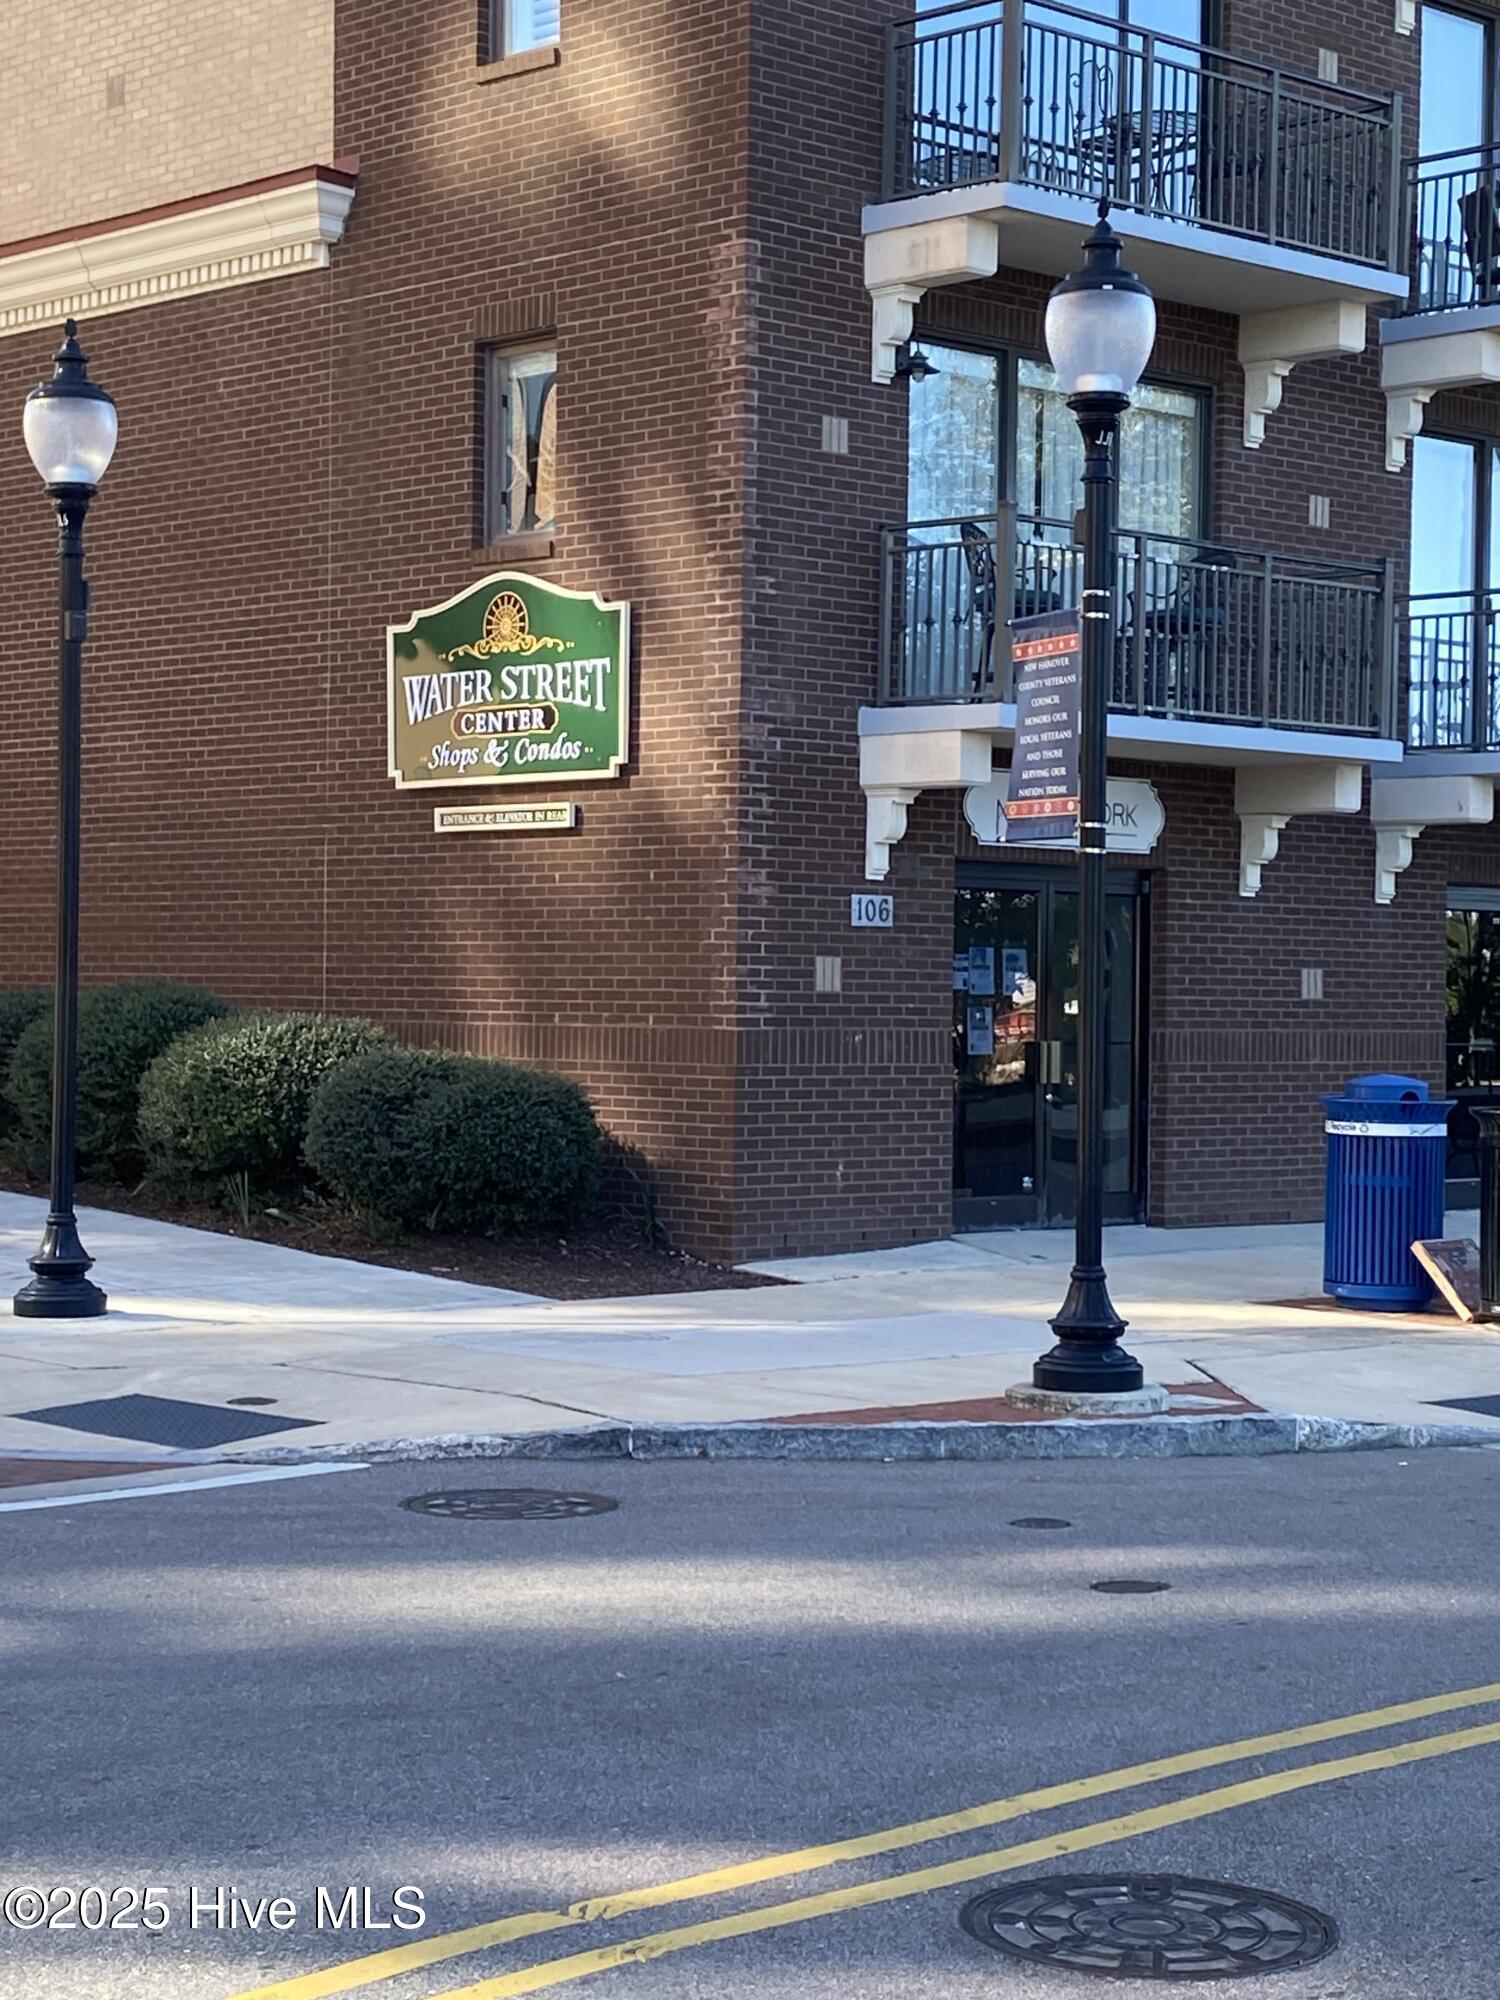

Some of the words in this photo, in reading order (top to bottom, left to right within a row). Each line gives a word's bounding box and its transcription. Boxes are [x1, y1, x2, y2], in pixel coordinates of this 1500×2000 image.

[1024, 662, 1037, 672] NEW
[1038, 656, 1070, 671] HANOVER
[1018, 679, 1043, 692] COUNTY
[1044, 673, 1077, 687] VETERANS
[402, 669, 494, 726] WATER
[501, 657, 611, 712] STREET
[1031, 695, 1060, 707] COUNCIL
[461, 708, 546, 735] CENTER
[1024, 714, 1051, 726] HONORS
[1052, 711, 1068, 723] OUR
[1020, 734, 1039, 745] LOCAL
[1040, 729, 1072, 742] VETERANS
[428, 741, 480, 774] Shops
[483, 739, 509, 767] &
[515, 732, 583, 765] Condos
[1026, 750, 1041, 761] AND
[1042, 748, 1063, 760] THOSE
[1022, 768, 1049, 780] SERVING
[1050, 766, 1066, 777] OUR
[1018, 785, 1044, 797] NATION
[1045, 785, 1068, 795] TODAY
[442, 813, 484, 825] ENTRANCE
[485, 813, 494, 824] &
[495, 811, 533, 823] ELEVATOR
[535, 810, 545, 821] IN
[857, 897, 890, 922] 106
